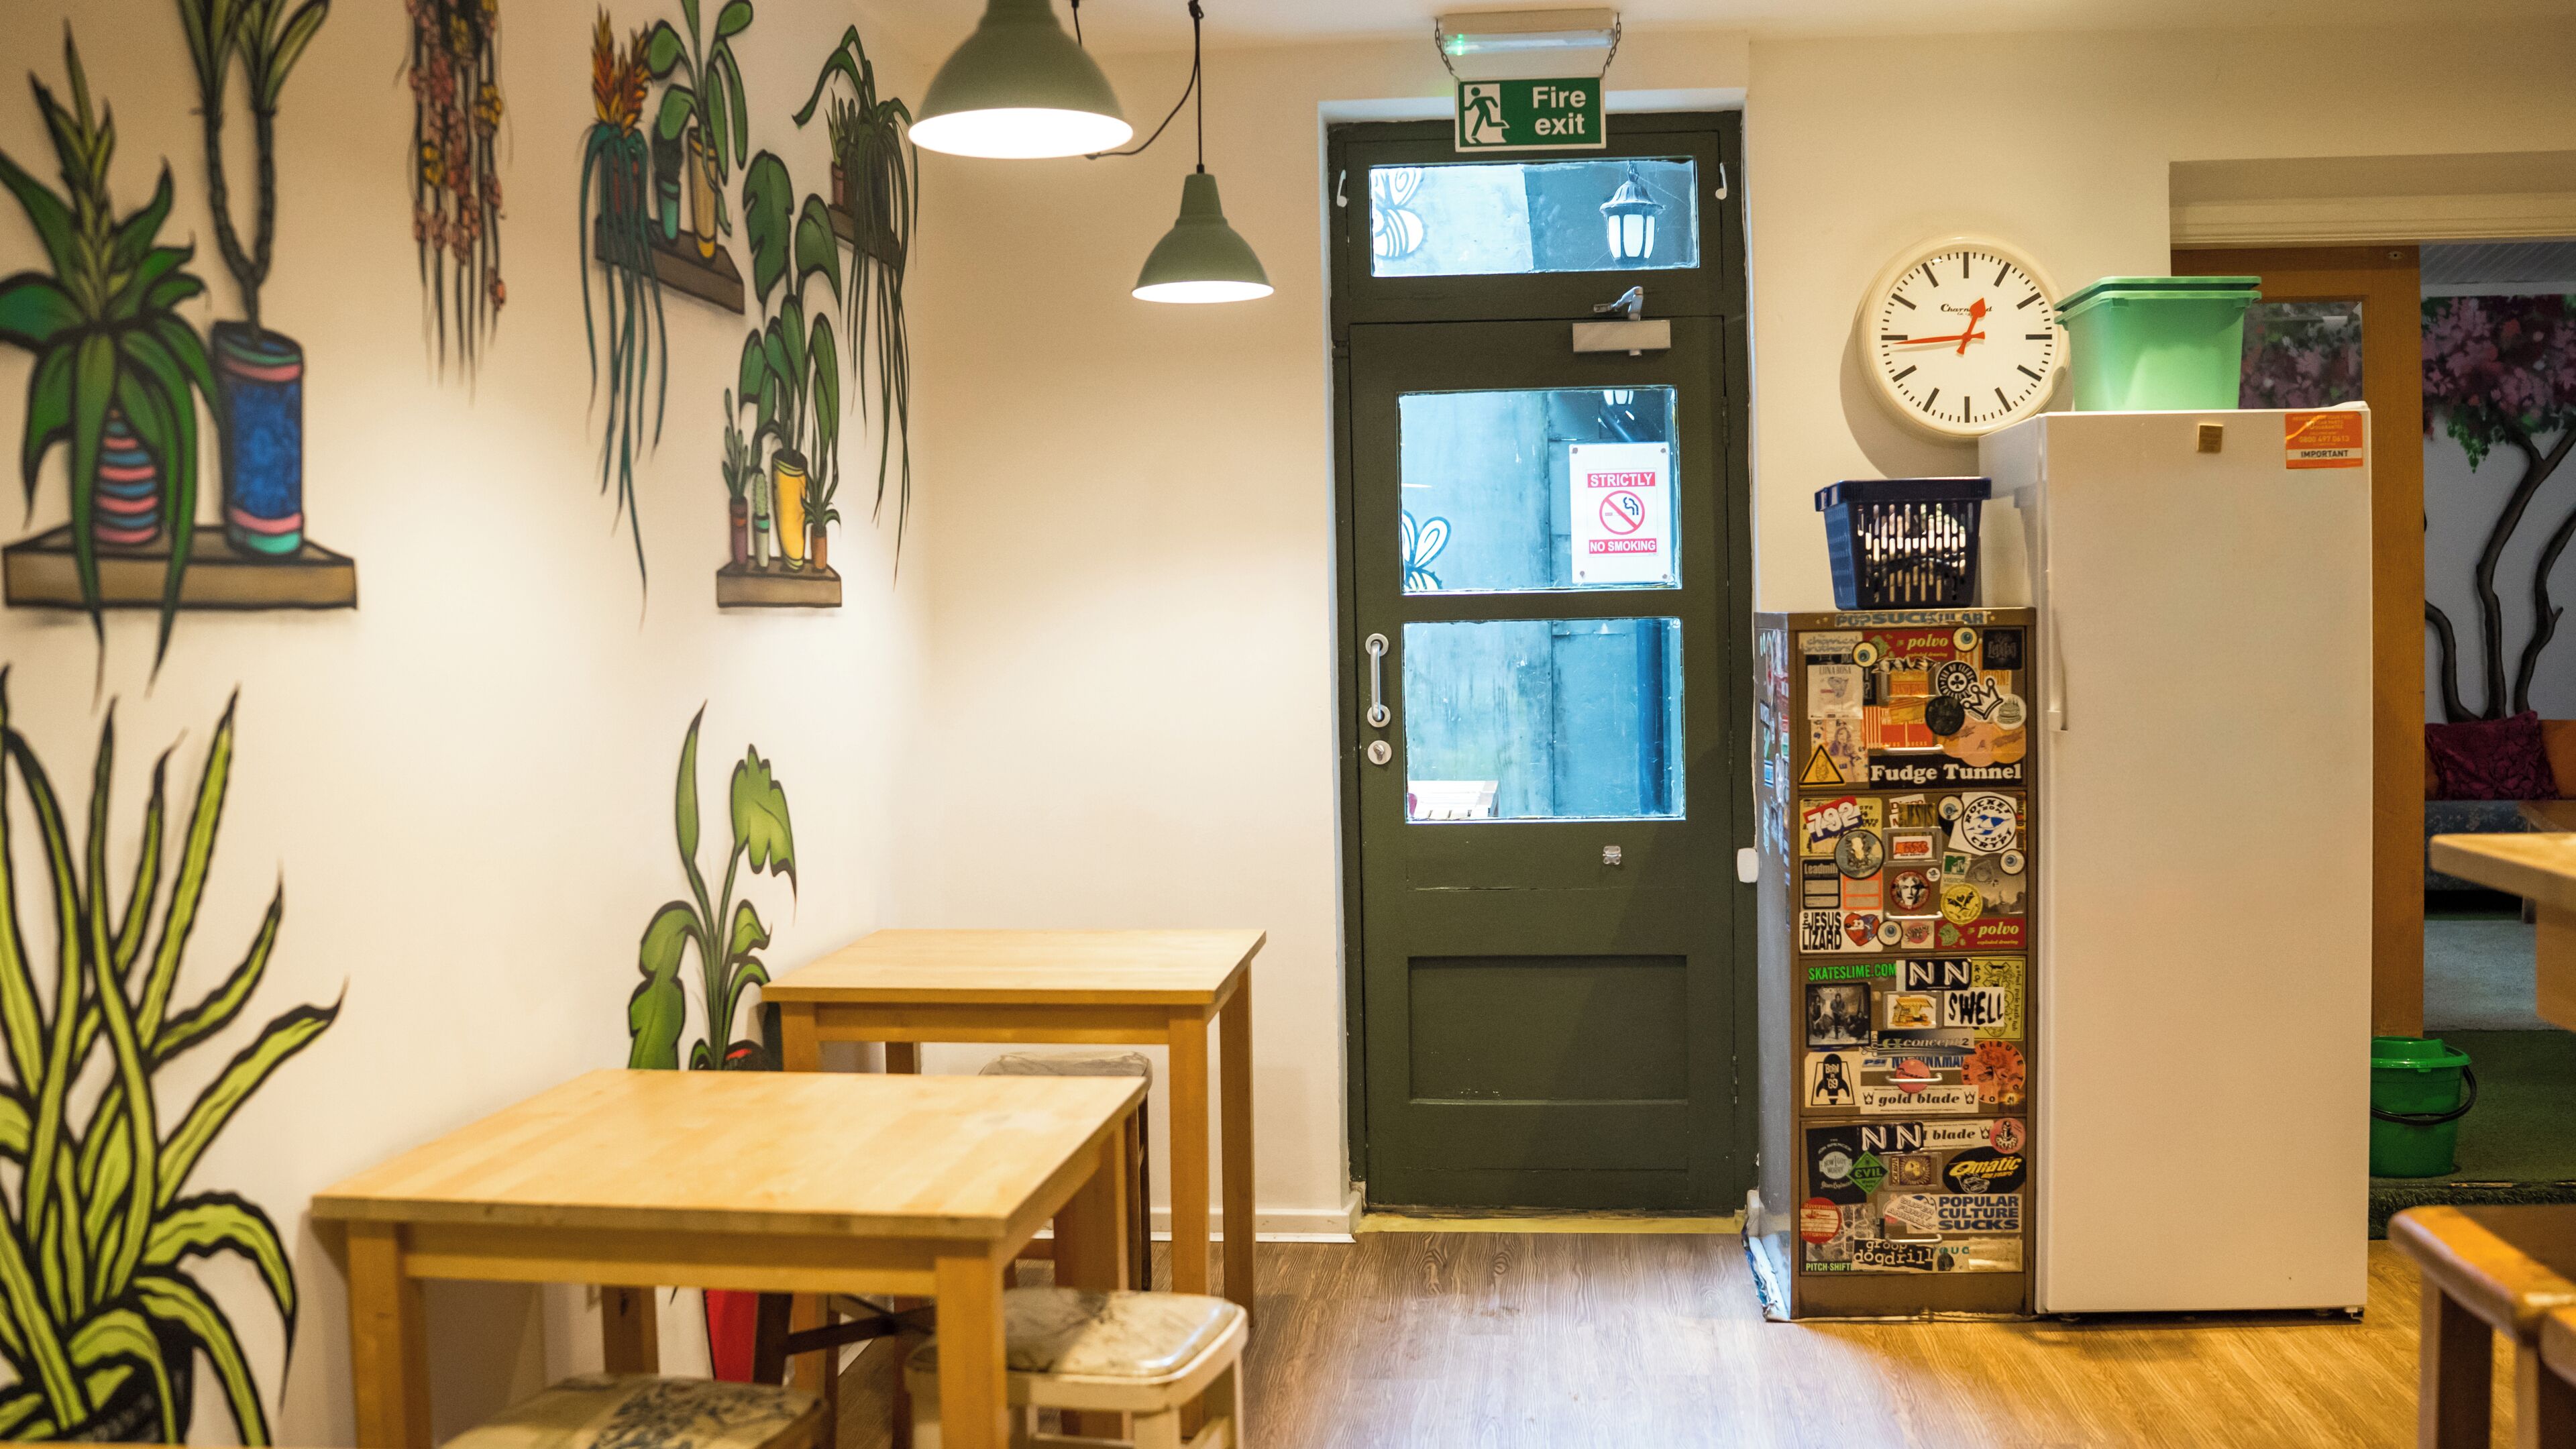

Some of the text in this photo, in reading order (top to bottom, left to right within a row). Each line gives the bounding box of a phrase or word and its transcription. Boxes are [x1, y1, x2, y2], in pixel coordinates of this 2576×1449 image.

[1532, 86, 1587, 109] Fire
[1534, 113, 1585, 136] exit
[1940, 303, 1992, 312] Charnd
[2301, 449, 2349, 458] IMPORTANT
[1590, 474, 1653, 487] STRICTLY
[1590, 540, 1656, 551] NO SMOKING
[1907, 633, 1949, 651] polvo
[1870, 763, 2022, 784] Fudge Tunnel
[1807, 802, 1859, 837] 792
[1965, 799, 2011, 824] ROCKET
[1971, 827, 2012, 849] CRYPT
[1809, 912, 1841, 930] JESUS
[1977, 922, 2019, 938] polvo
[1802, 929, 1842, 951] LIZARD
[1808, 963, 1897, 981] SKATESLIME.COM
[1948, 991, 2004, 1025] SWELL
[1978, 1040, 2025, 1066] RIBUTE
[1825, 1063, 1839, 1073] BORN
[1827, 1078, 1838, 1089] '69
[1878, 1093, 1960, 1107] gold blade
[1932, 1129, 1976, 1140] blade
[1854, 1168, 1883, 1178] EVIL
[1939, 1196, 2019, 1207] POPULAR
[1938, 1208, 2019, 1218] CULTURE
[1938, 1220, 2019, 1230] SUCKS
[1854, 1248, 1933, 1265] dogdrill
